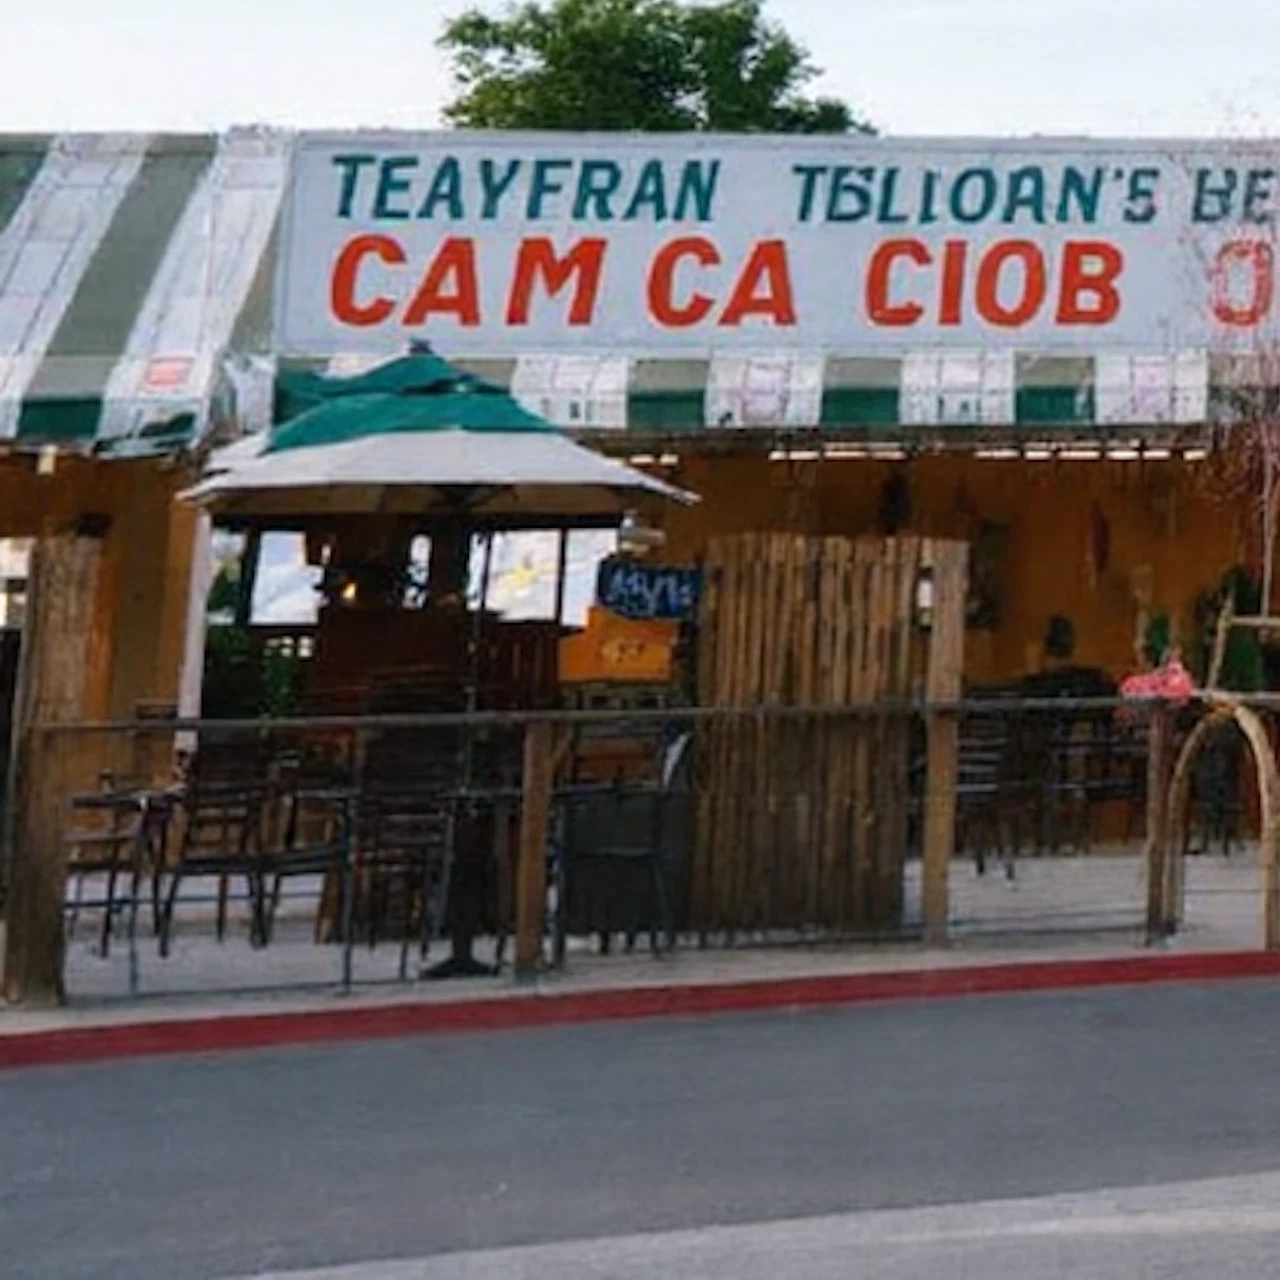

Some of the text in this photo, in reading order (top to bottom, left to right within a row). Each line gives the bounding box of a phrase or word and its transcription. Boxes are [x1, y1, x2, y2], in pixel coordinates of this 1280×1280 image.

[331, 153, 722, 222] TEAYFRAN
[331, 236, 605, 326] CAM
[647, 238, 792, 327] CA
